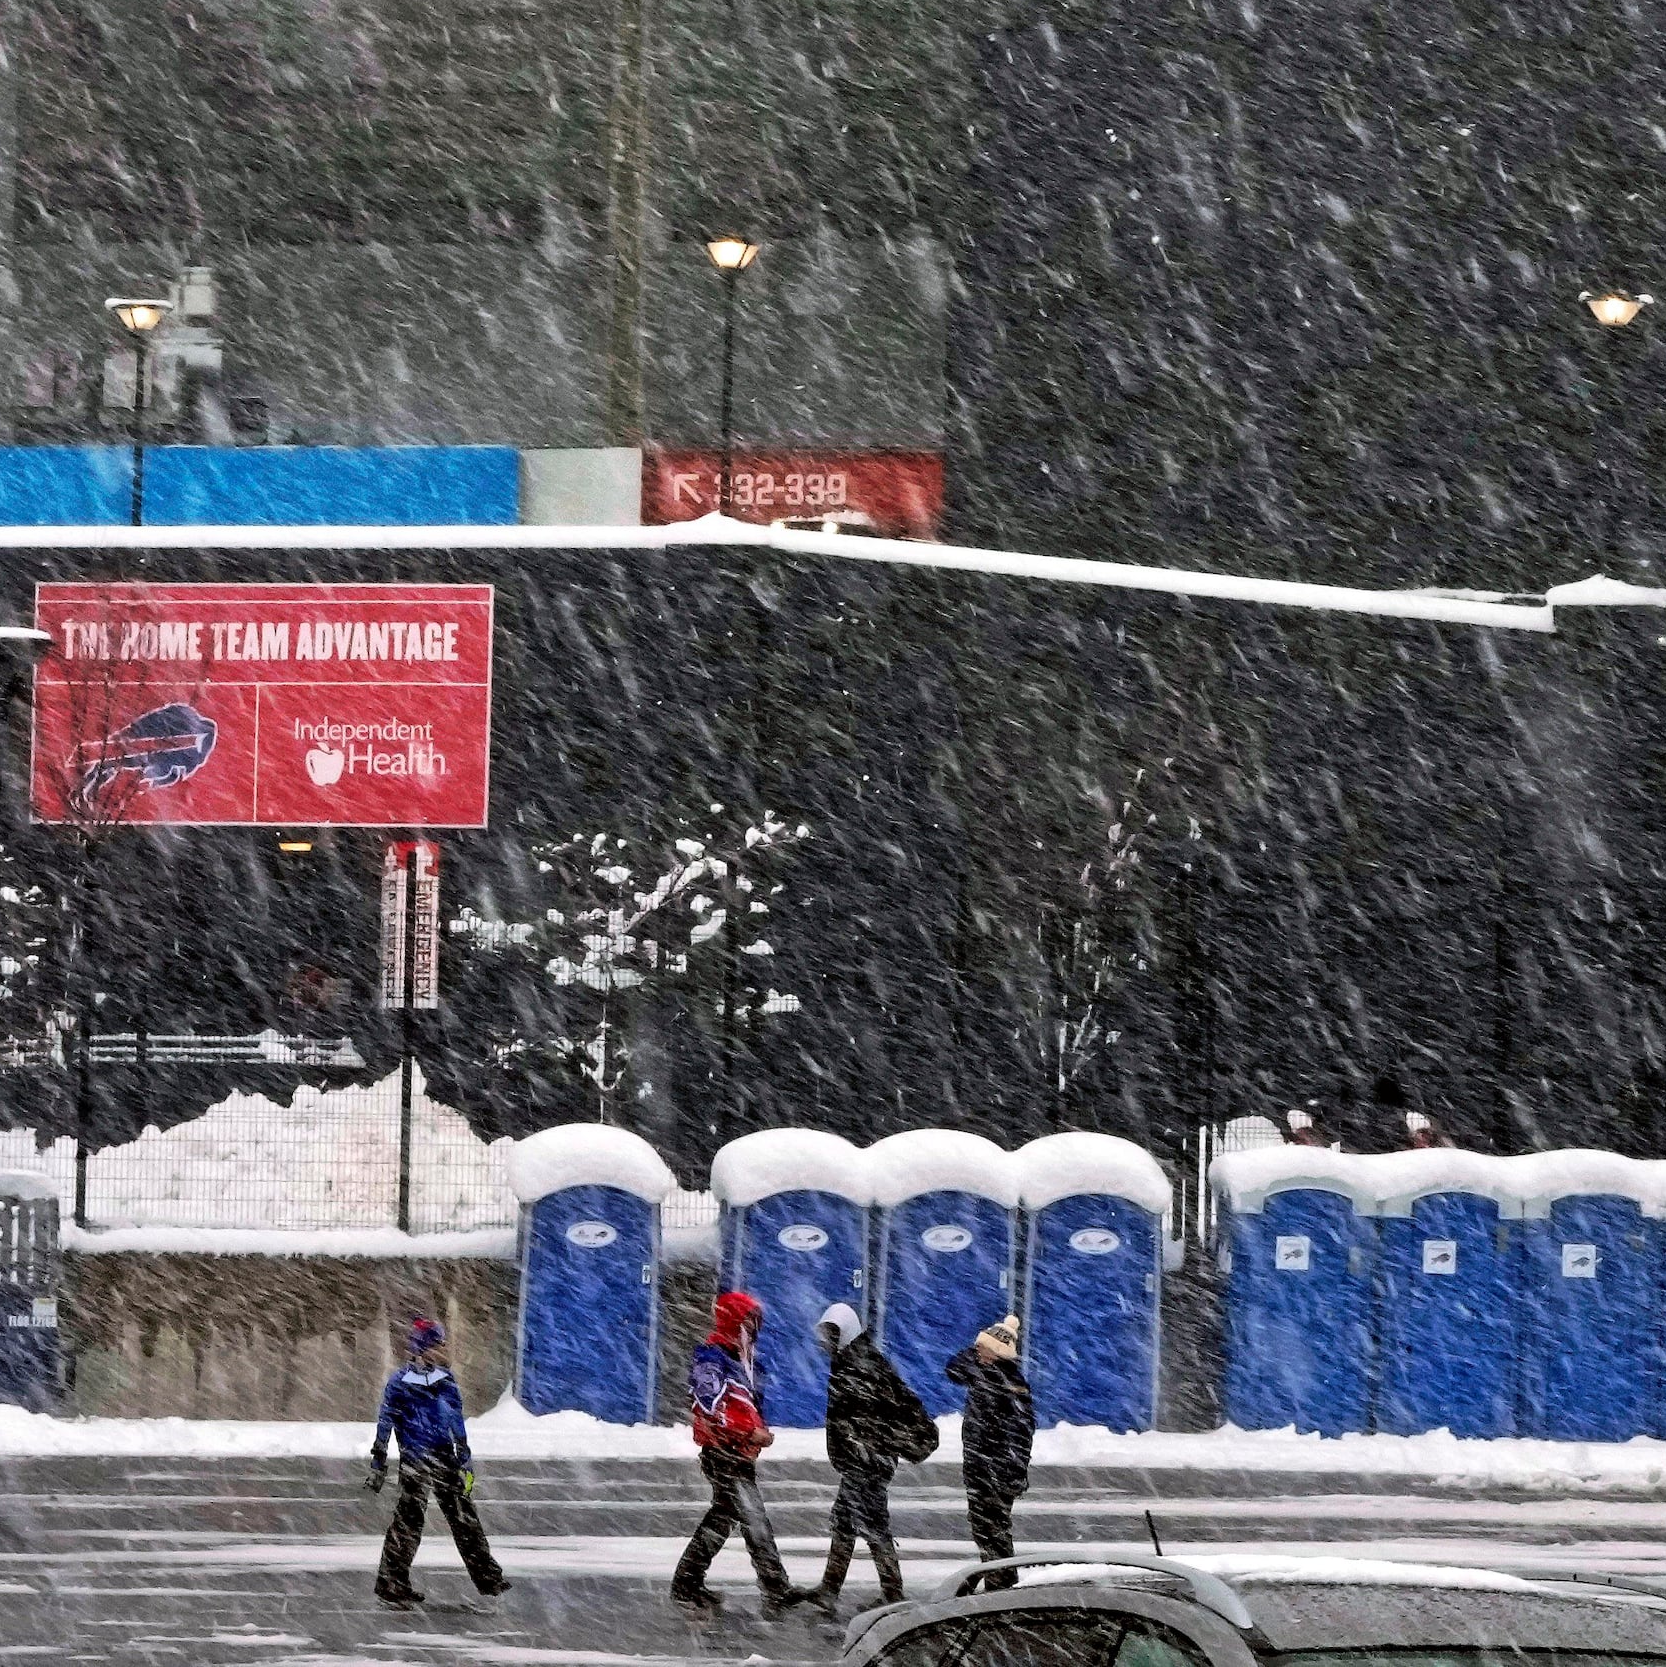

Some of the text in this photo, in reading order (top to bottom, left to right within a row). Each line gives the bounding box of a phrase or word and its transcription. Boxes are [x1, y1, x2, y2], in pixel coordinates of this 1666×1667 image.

[120, 621, 203, 661] HOME
[210, 621, 290, 661] TEAM
[296, 621, 460, 662] ADVANTAGE
[294, 717, 434, 748] Independent
[348, 743, 446, 774] Health
[415, 879, 432, 1000] EMERGENCY
